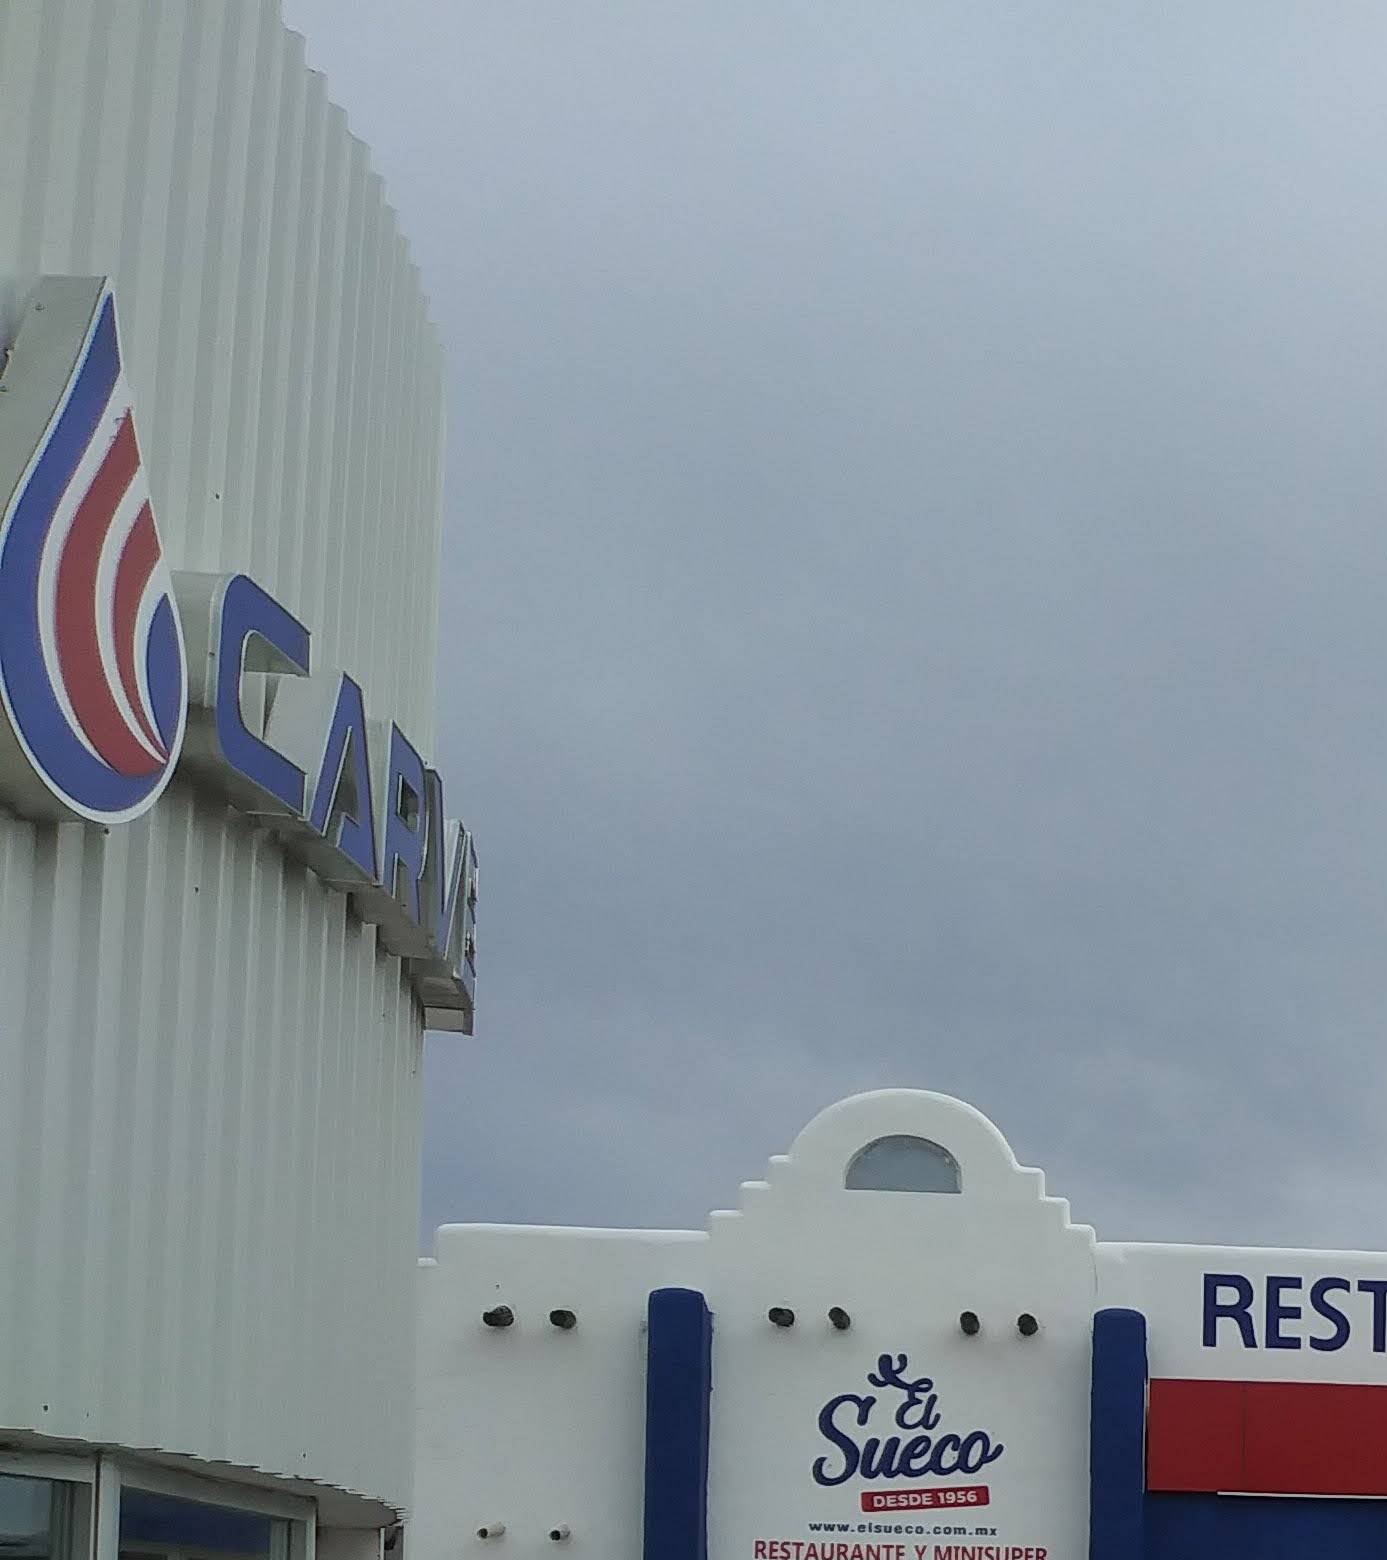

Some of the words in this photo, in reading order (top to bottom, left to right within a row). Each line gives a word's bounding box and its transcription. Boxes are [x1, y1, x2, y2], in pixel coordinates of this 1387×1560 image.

[811, 1393, 1004, 1487] Sueco
[872, 1495, 933, 1508] DESDE
[937, 1490, 977, 1505] 1956
[808, 1522, 997, 1537] www.elsueco.com.mx
